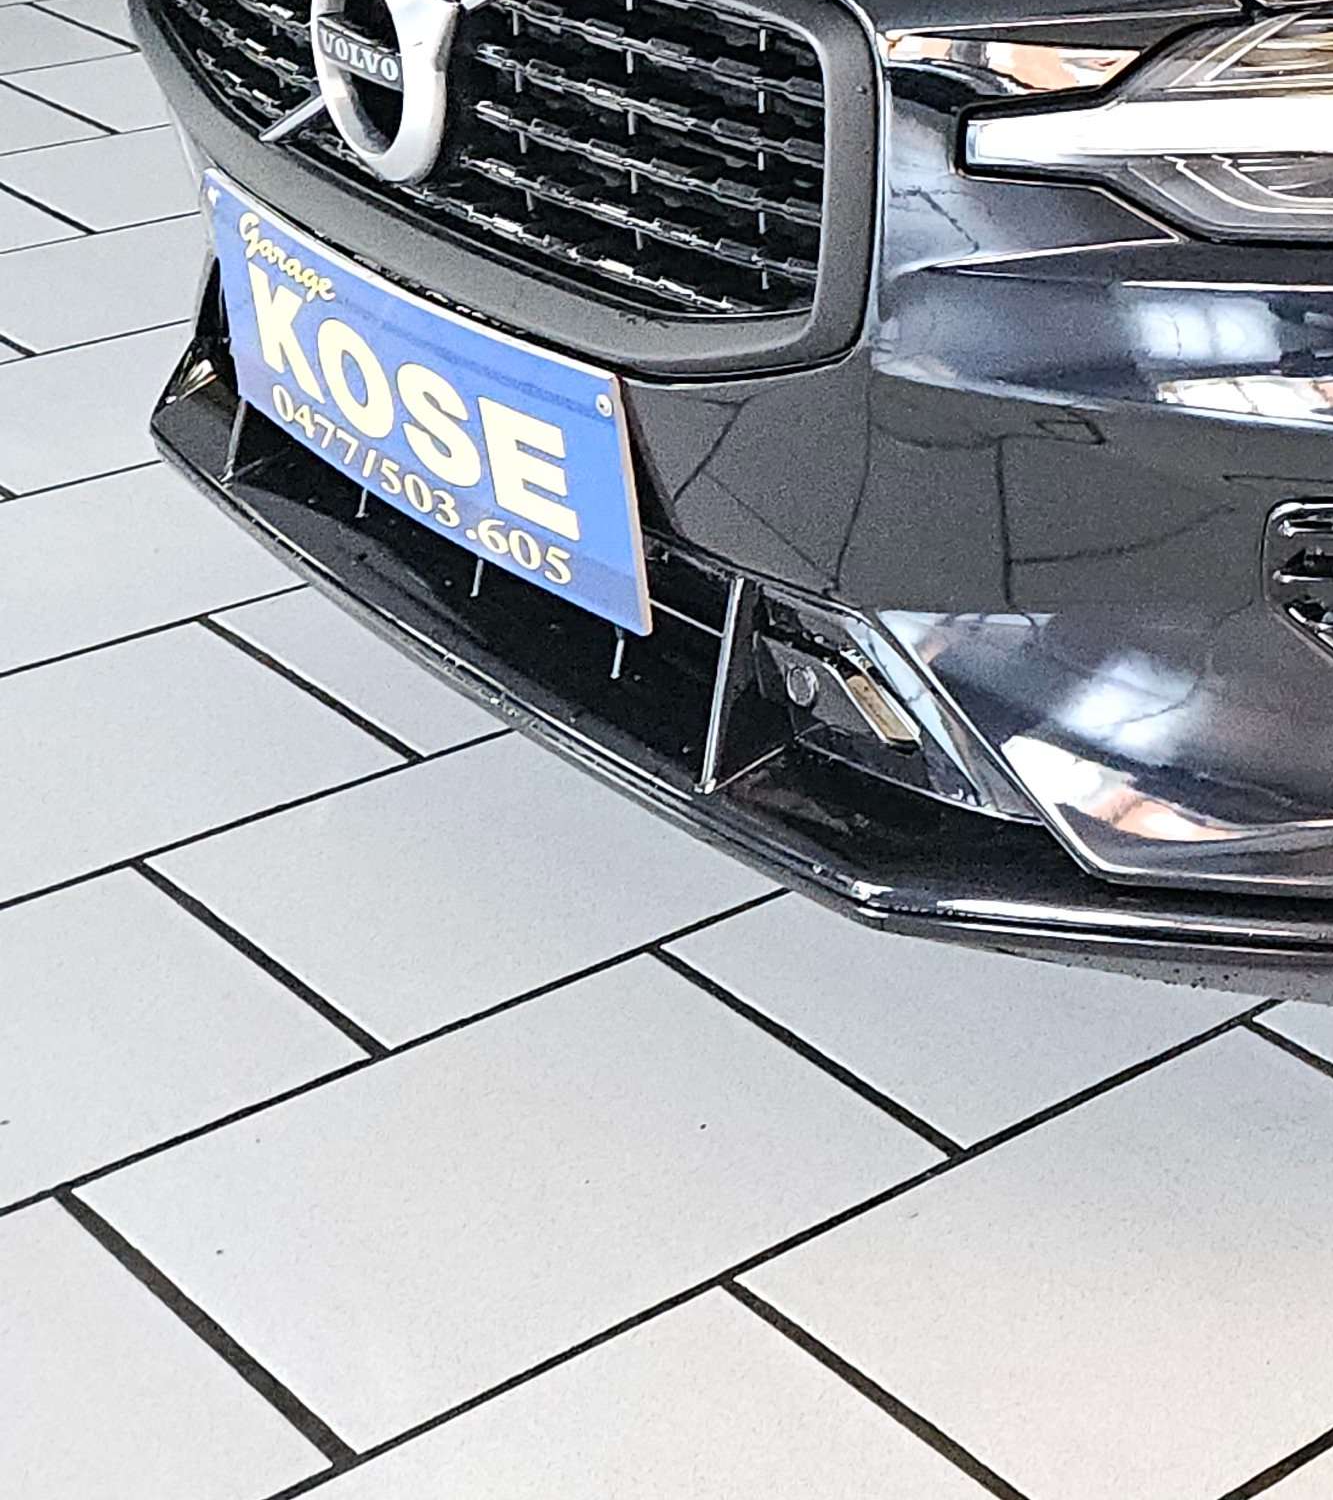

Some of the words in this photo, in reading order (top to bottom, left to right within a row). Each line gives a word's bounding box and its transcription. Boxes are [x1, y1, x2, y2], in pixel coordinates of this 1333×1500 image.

[319, 27, 399, 82] VOLVO
[239, 212, 336, 301] Garage
[248, 261, 581, 541] KOSE
[272, 384, 573, 585] 0477/503.605
